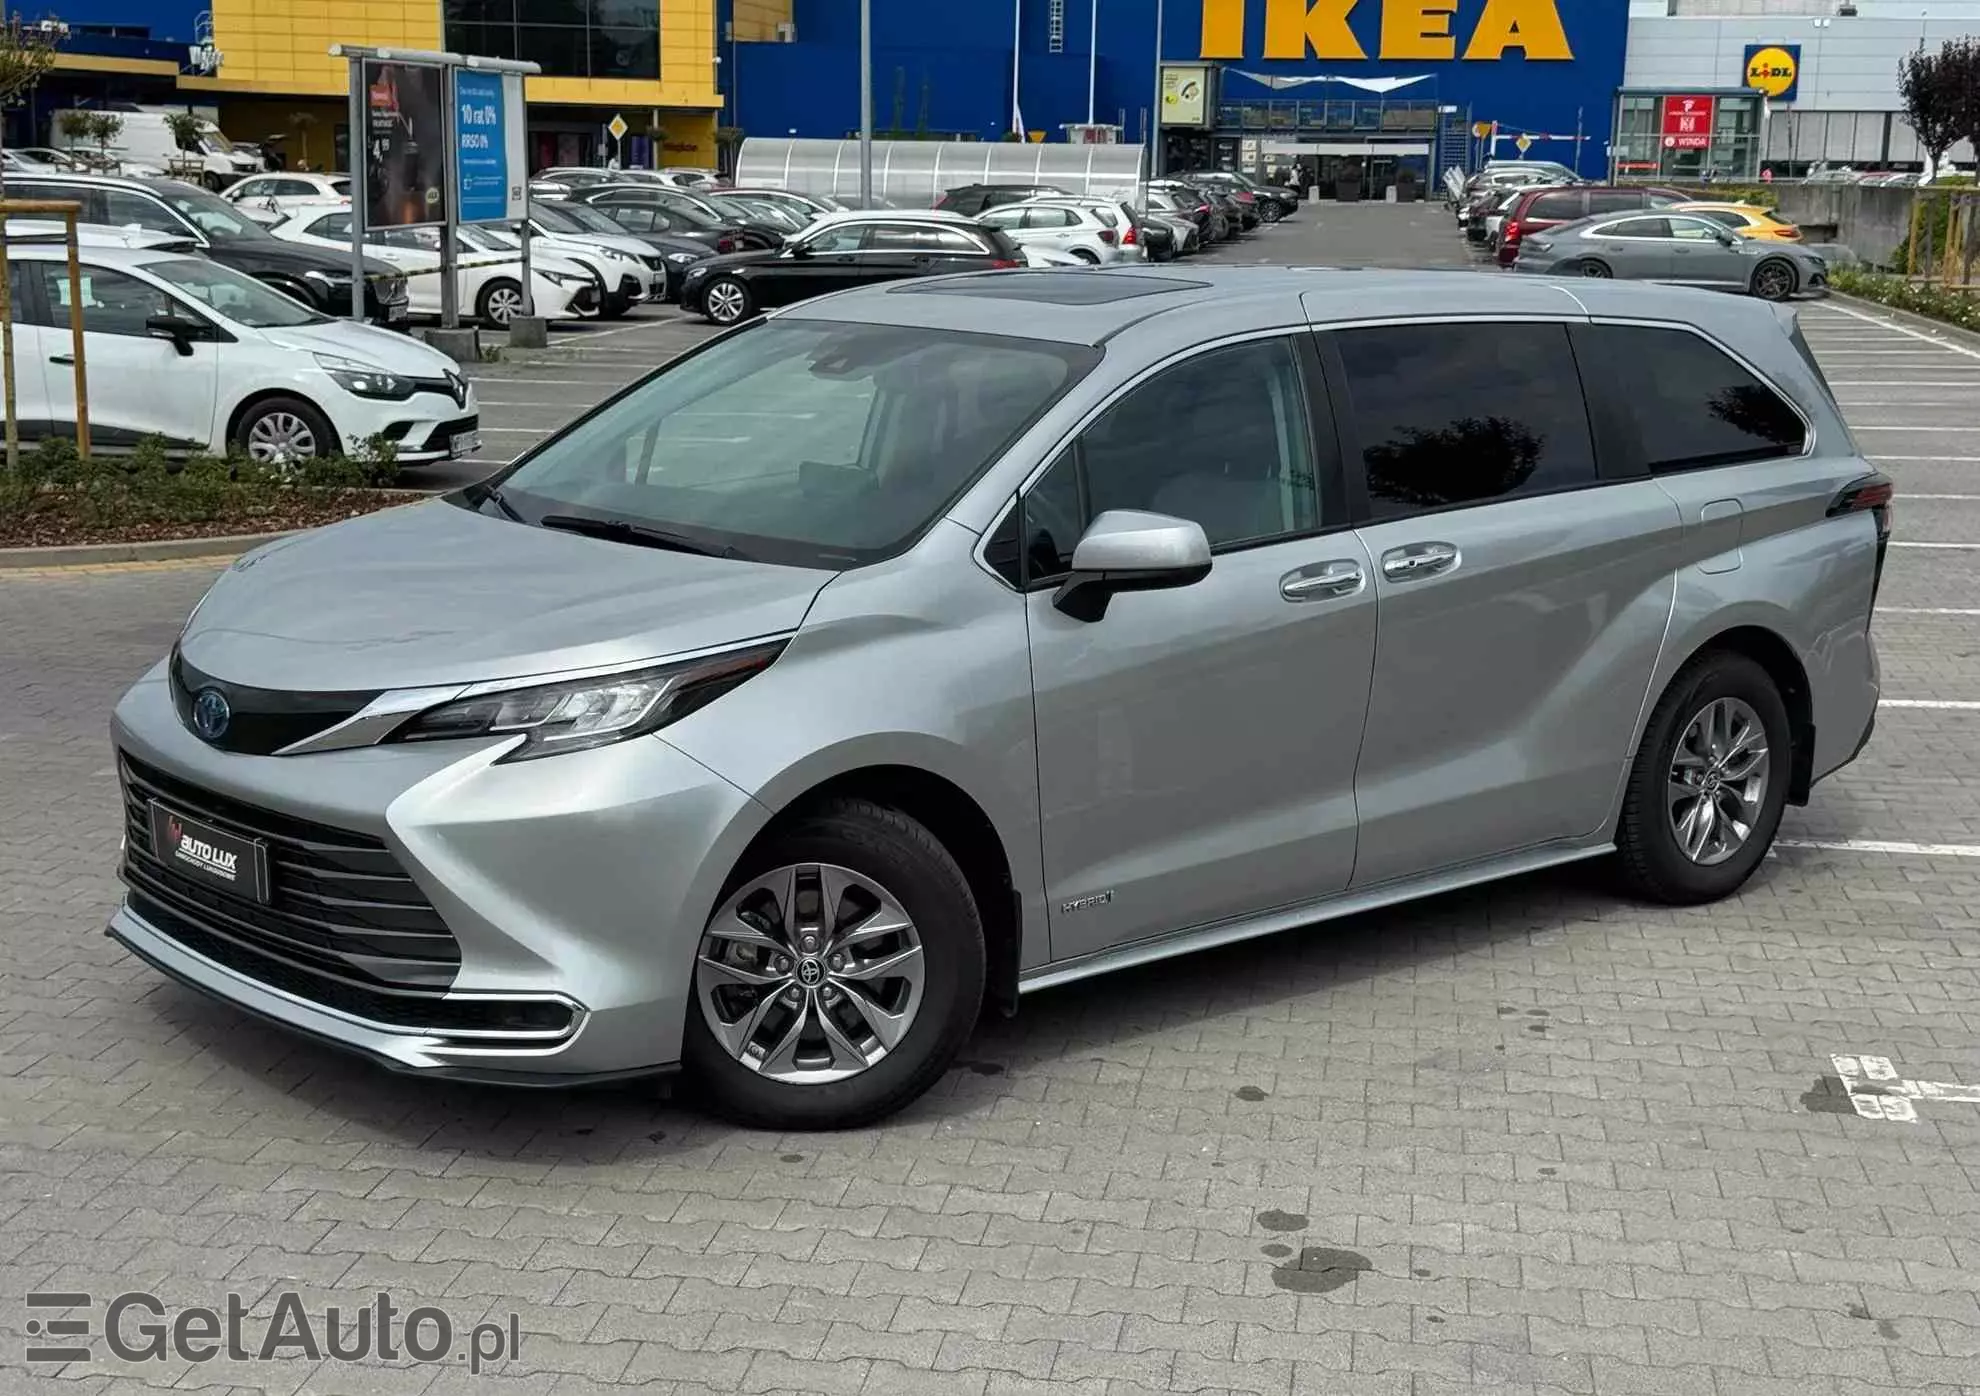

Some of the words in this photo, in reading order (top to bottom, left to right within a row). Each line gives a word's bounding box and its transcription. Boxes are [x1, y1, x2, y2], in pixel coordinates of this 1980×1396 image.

[1200, 0, 1574, 60] IKEA
[462, 104, 473, 124] 10
[485, 105, 497, 125] 0%
[1678, 137, 1707, 147] WINDA
[212, 847, 237, 869] LUX
